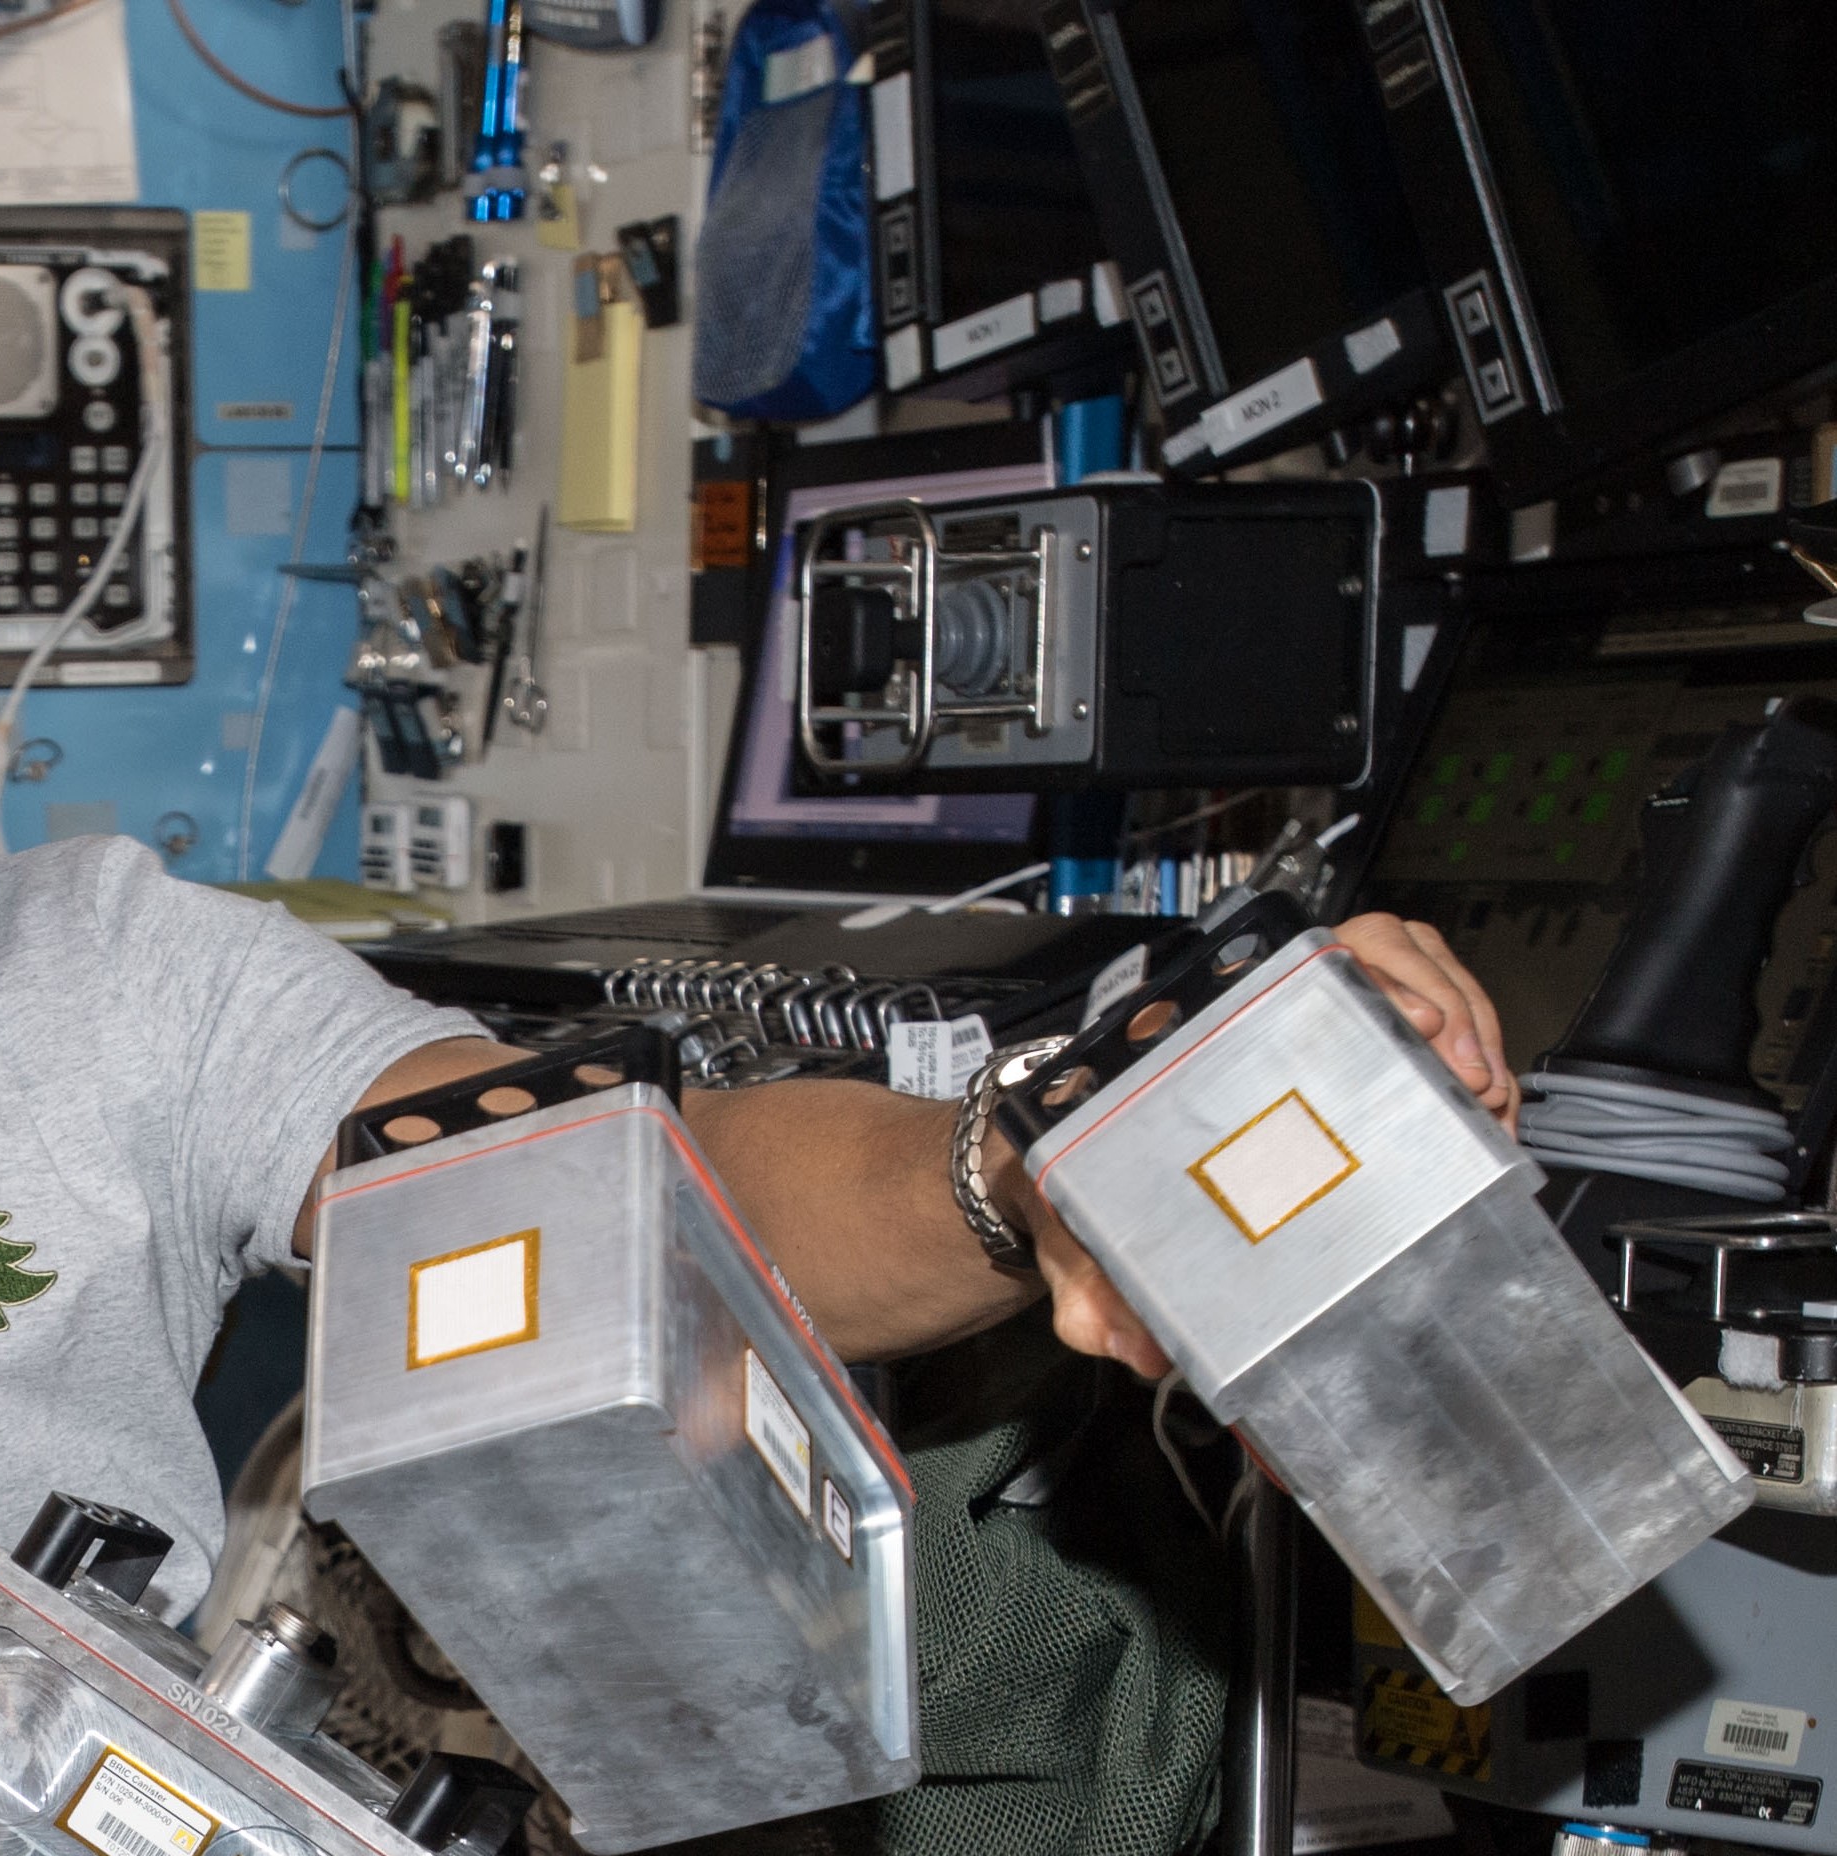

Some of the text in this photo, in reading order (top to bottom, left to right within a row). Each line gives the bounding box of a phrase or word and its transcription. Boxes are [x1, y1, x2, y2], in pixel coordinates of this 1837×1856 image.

[1242, 398, 1272, 421] MON
[831, 1491, 846, 1546] E
[167, 1681, 243, 1741] SN 024
[94, 1781, 109, 1796] S/N
[108, 1759, 167, 1802] BRIC Canister
[1735, 1783, 1787, 1798] AEROSPACE
[1746, 1775, 1790, 1787] ASSEMBLY
[100, 1772, 173, 1827] P/N 1029-M-3000-00
